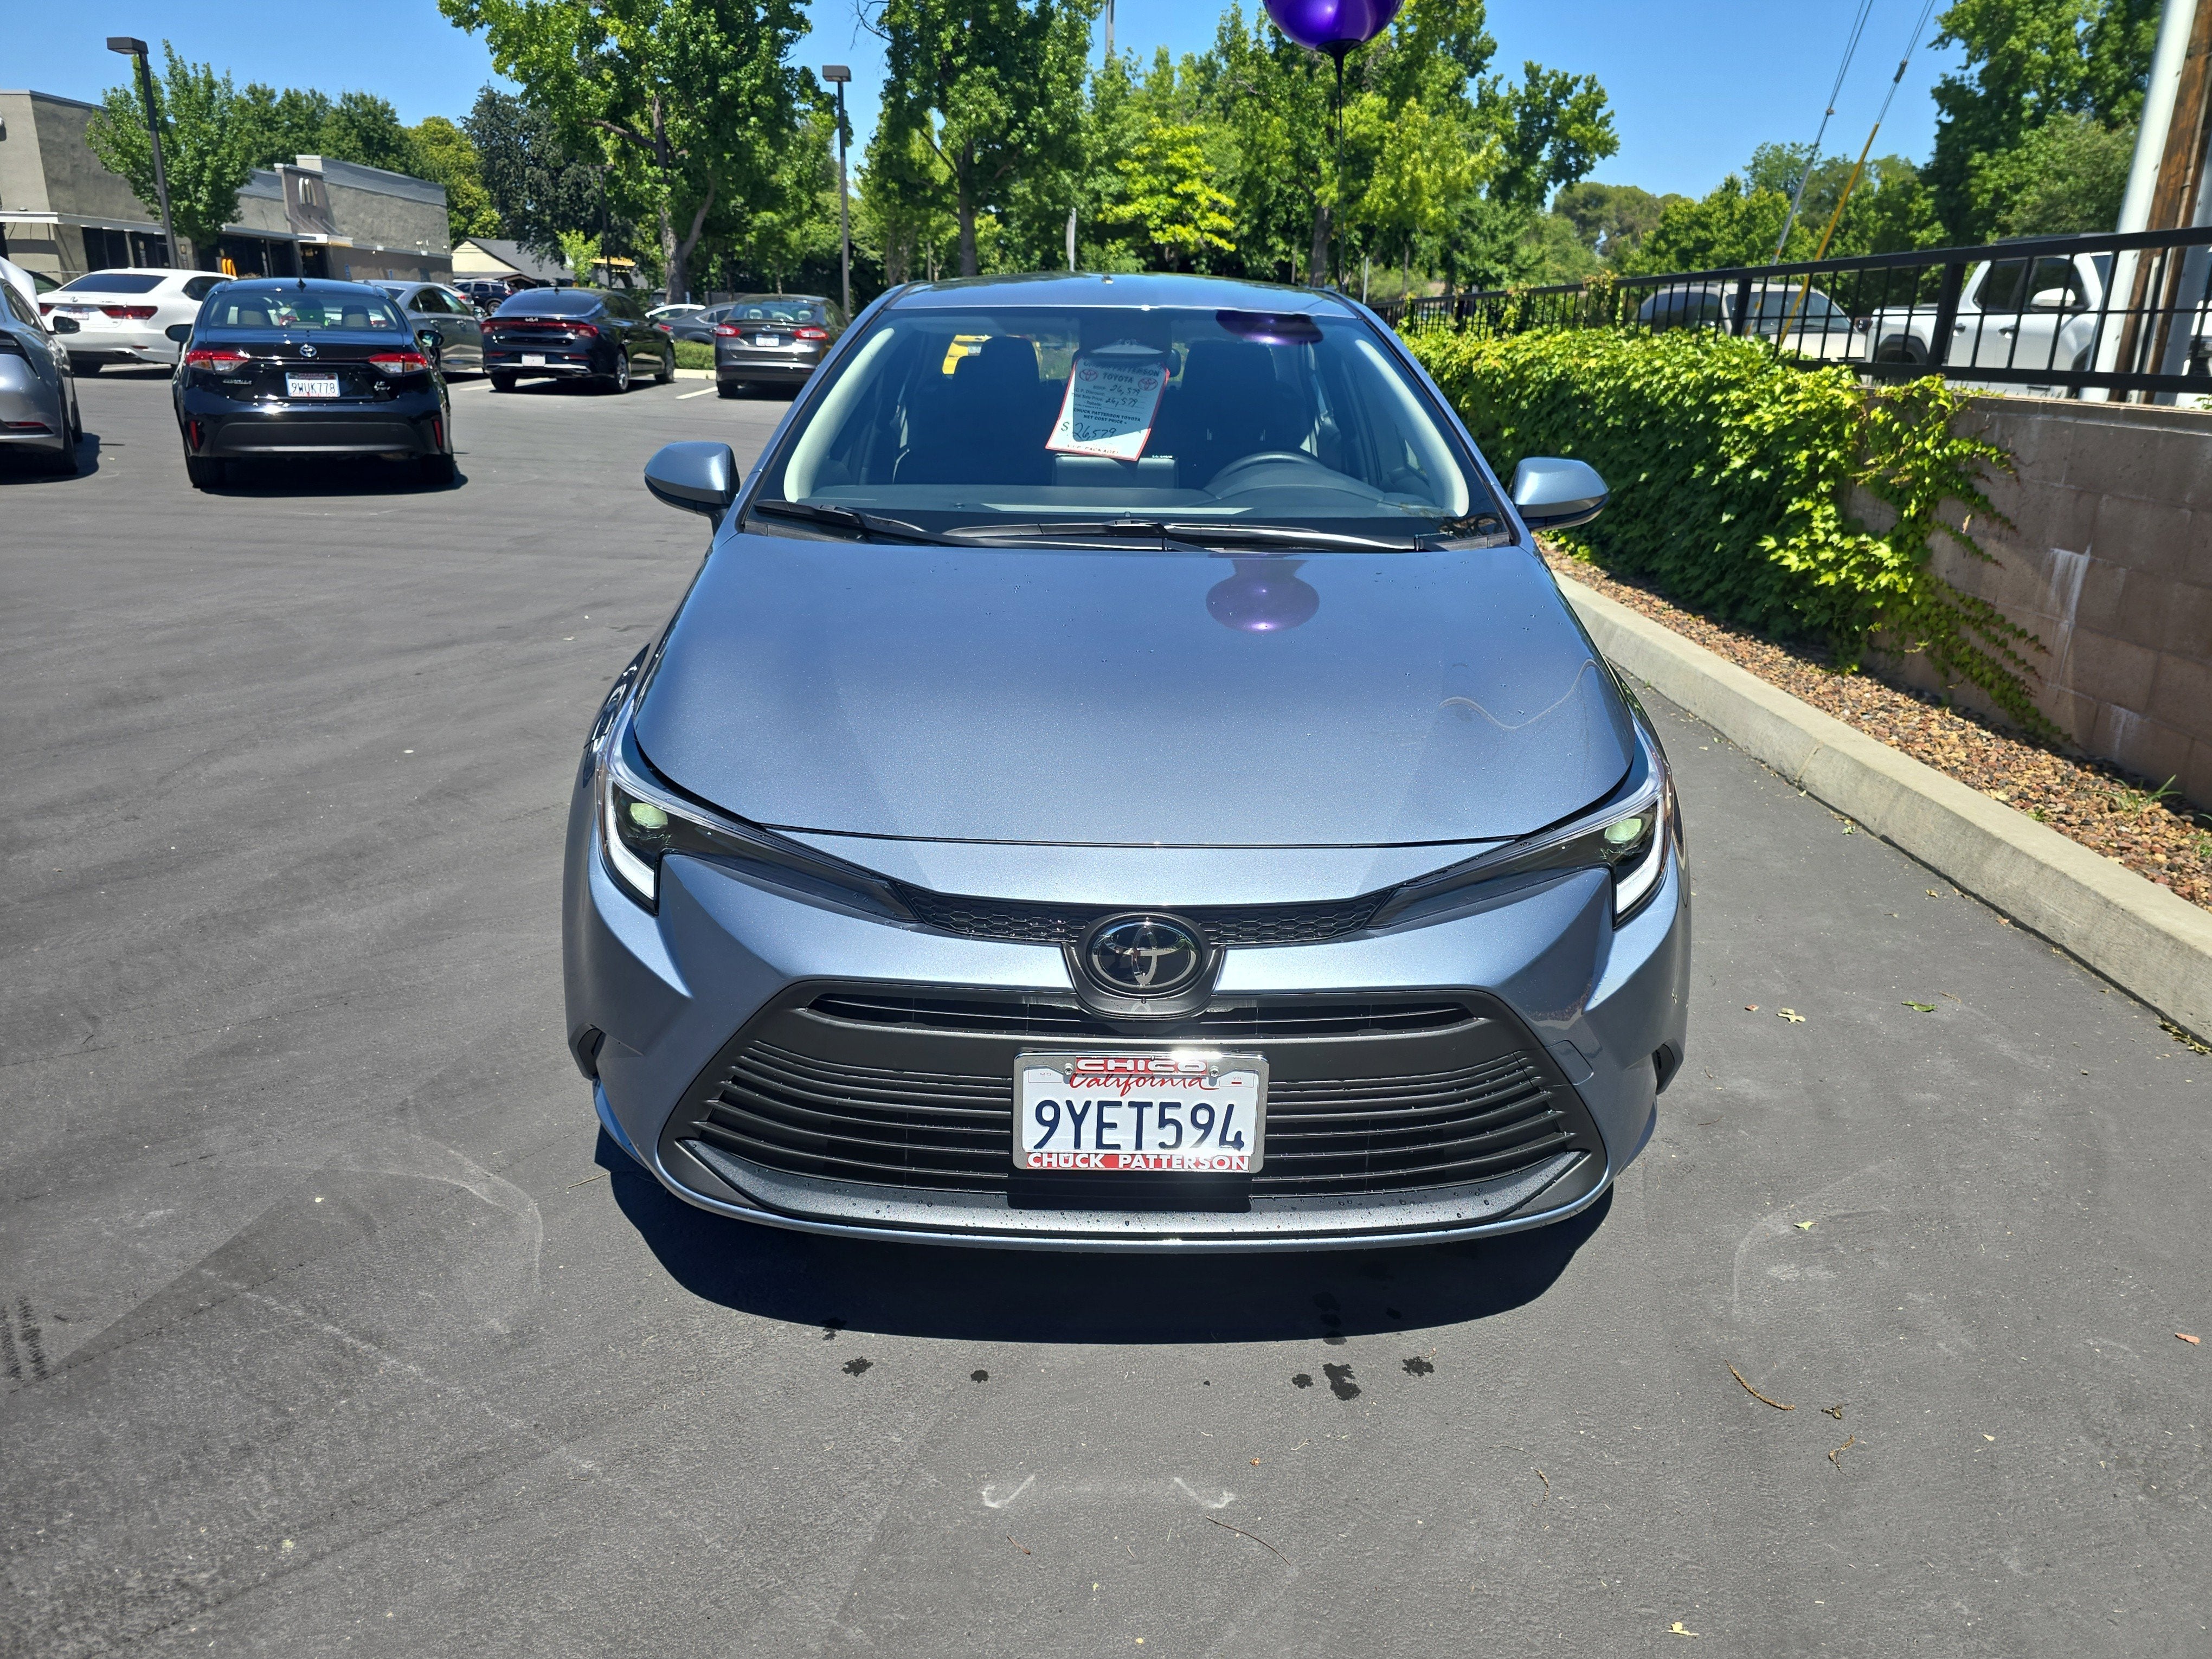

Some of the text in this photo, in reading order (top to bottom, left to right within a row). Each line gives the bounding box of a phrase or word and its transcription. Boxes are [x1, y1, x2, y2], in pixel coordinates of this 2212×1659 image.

[1103, 372, 1133, 383] TOYOTA
[292, 382, 336, 394] 9WUK778
[1105, 397, 1138, 408] 26,579
[1091, 410, 1120, 419] PATTERSON
[1073, 422, 1116, 441] 26,579
[1077, 1059, 1207, 1072] CHICO
[1069, 1073, 1219, 1097] California
[1033, 1099, 1245, 1151] 9YET594
[1027, 1153, 1249, 1171] CHUCK PATTERSON
